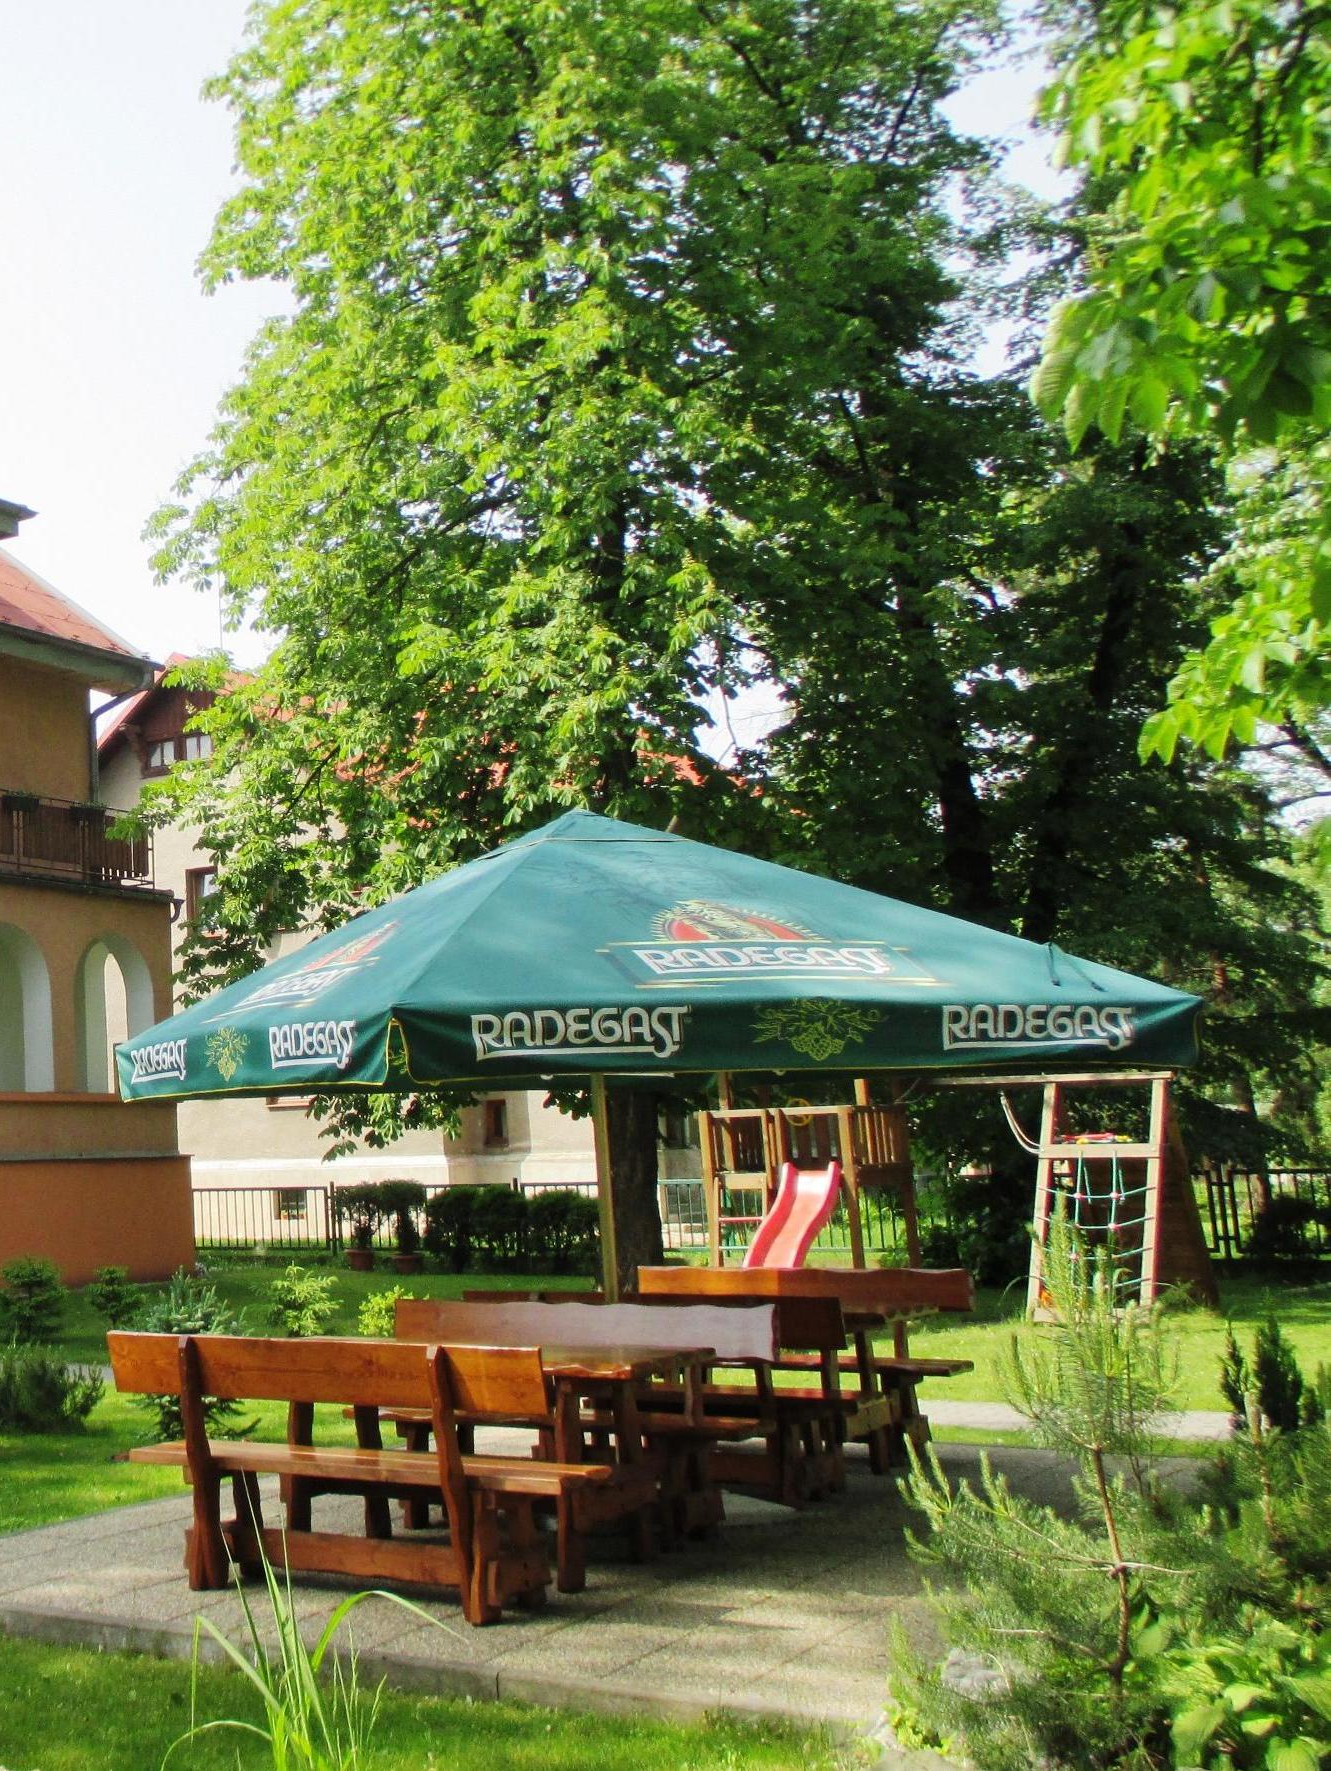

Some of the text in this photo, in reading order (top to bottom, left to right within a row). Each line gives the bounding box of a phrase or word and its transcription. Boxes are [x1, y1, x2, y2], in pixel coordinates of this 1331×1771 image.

[631, 947, 893, 974] RADEGAST
[269, 1020, 356, 1069] RADEGAST
[471, 1006, 689, 1063] RADEGAST
[942, 1004, 1135, 1051] RADEGAST
[130, 1036, 188, 1084] RADEGAST
